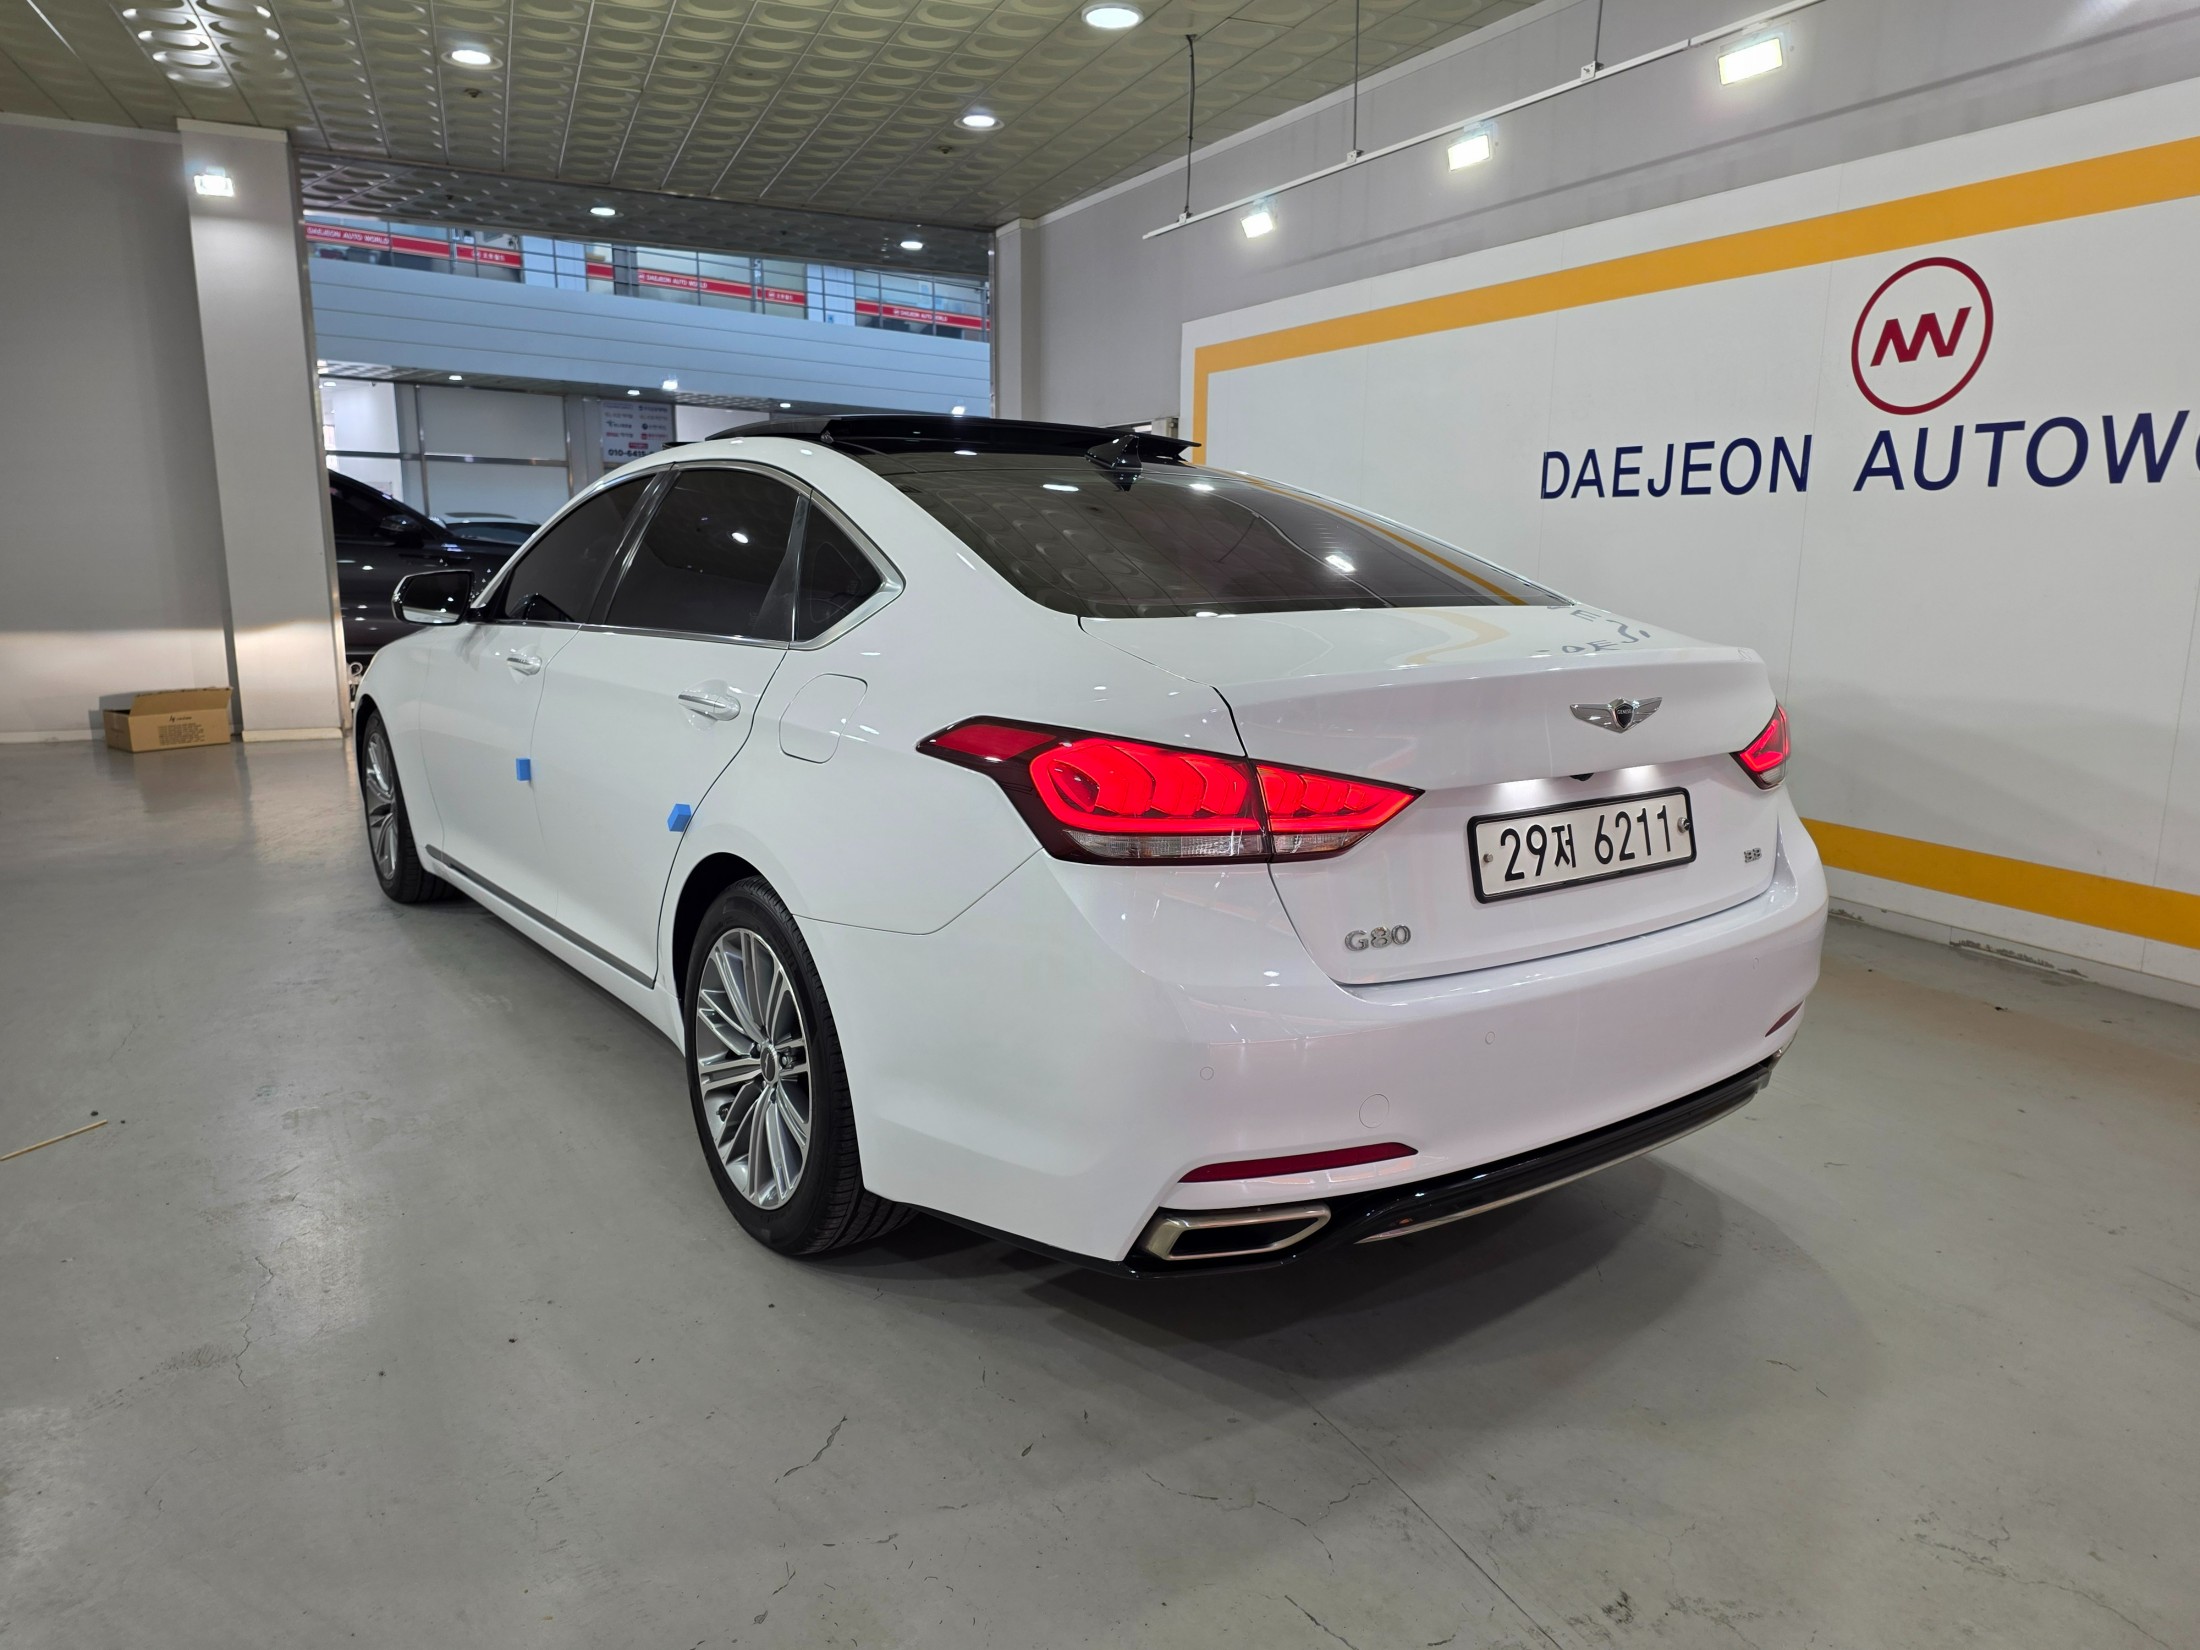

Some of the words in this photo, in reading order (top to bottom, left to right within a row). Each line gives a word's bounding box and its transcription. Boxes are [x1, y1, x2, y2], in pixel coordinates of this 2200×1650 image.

[343, 231, 363, 241] AUTO
[1540, 434, 1812, 500] DAEJEON
[1852, 409, 2200, 492] AUTOW
[1500, 823, 1576, 882] 29저
[1594, 804, 1671, 865] 6211
[1344, 924, 1411, 952] G80
